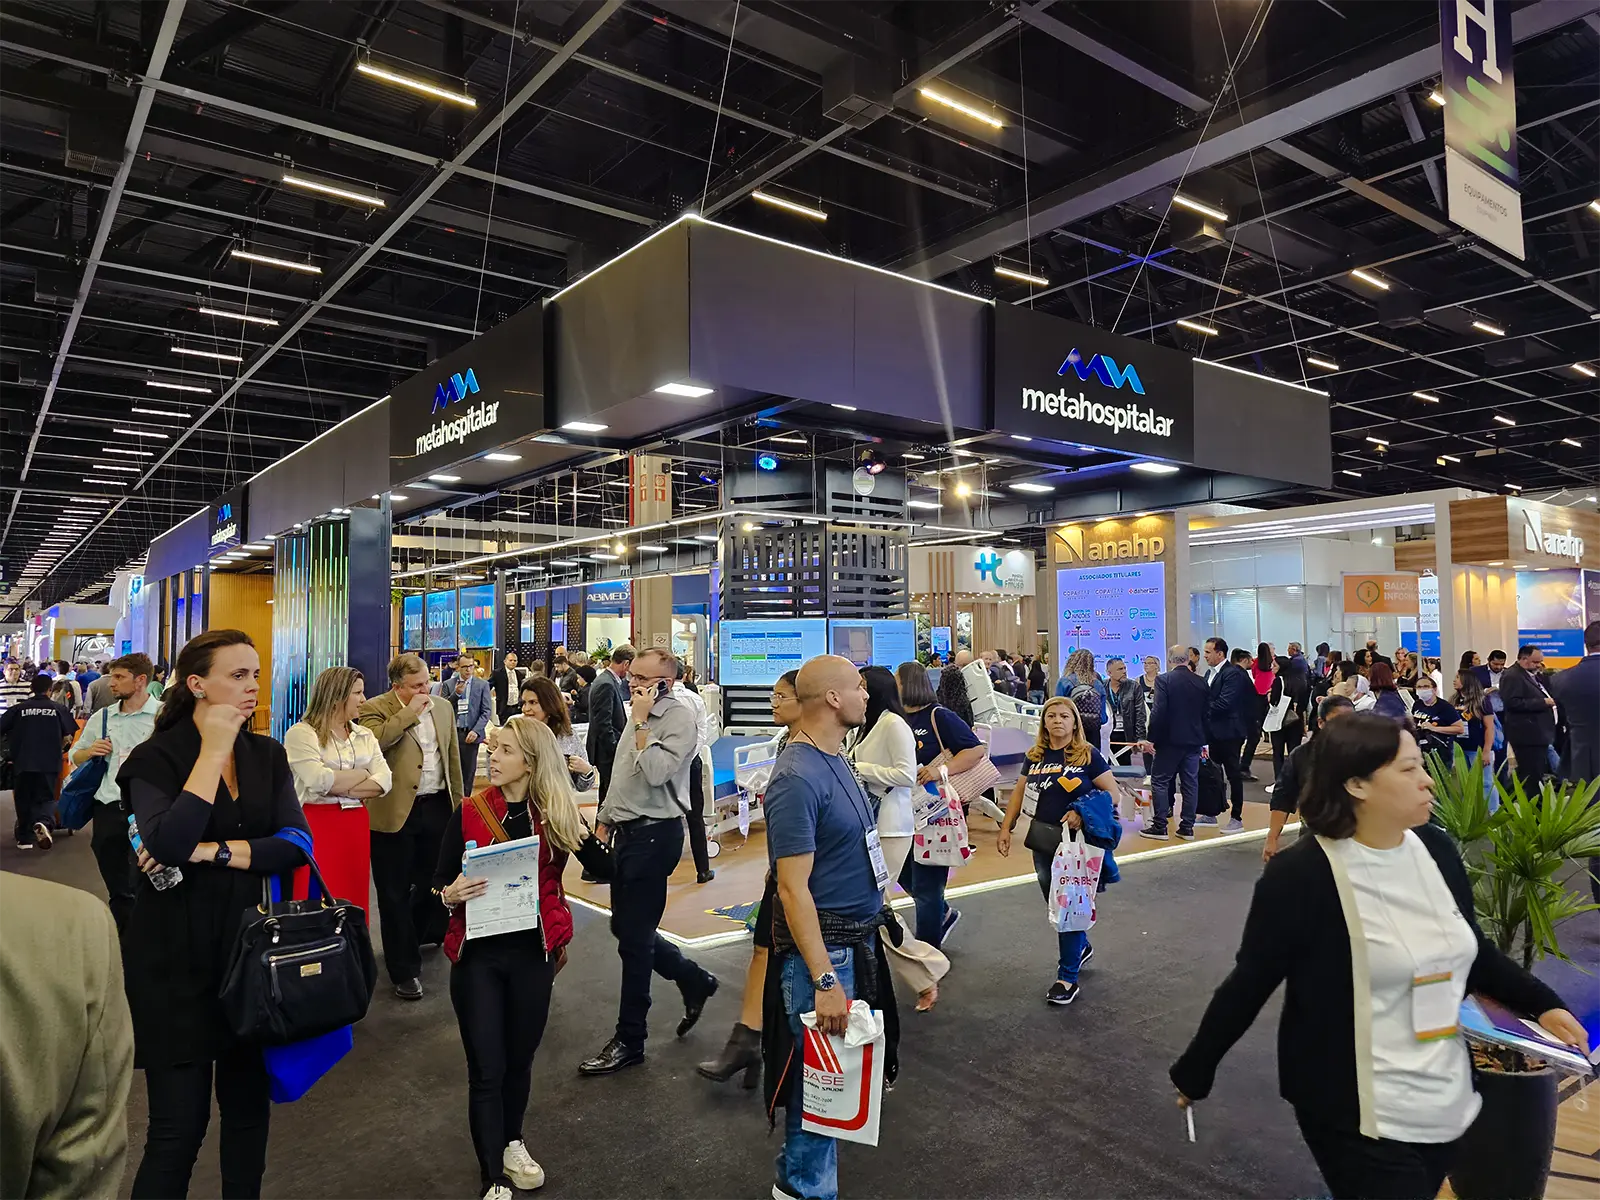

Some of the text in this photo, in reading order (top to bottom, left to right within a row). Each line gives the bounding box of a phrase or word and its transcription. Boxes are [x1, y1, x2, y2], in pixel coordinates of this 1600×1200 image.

[1463, 183, 1508, 218] EQUIPAMENTOS
[416, 401, 500, 456] metahospitalar
[1022, 387, 1174, 437] metahospitalar
[1088, 533, 1165, 562] anahp
[1542, 529, 1584, 564] anahp
[21, 708, 57, 717] LIMPEZA
